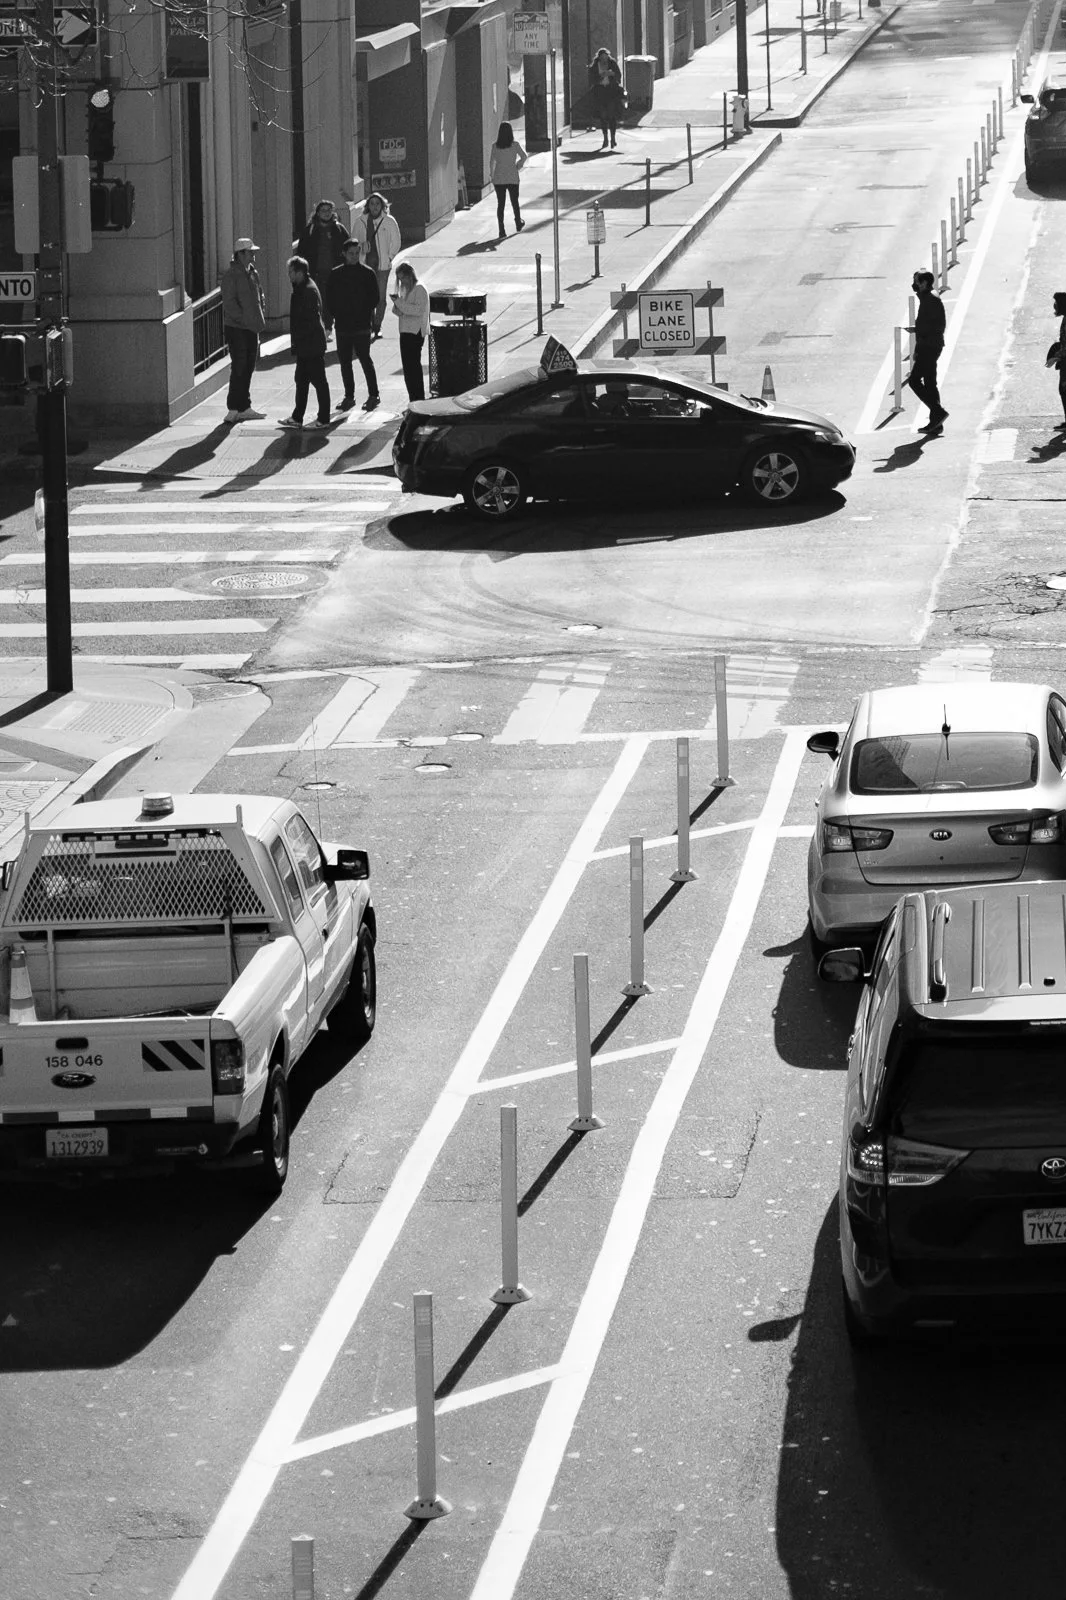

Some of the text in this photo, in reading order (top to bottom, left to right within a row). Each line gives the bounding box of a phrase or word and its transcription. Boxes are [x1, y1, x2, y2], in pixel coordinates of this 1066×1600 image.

[525, 32, 538, 41] ANY
[524, 41, 540, 49] TIME
[383, 140, 403, 149] FDC
[650, 300, 684, 312] BIKE
[648, 315, 686, 327] LANE
[644, 330, 691, 342] CLOSED
[933, 831, 949, 839] KIA
[45, 1055, 103, 1068] 158 046
[51, 1139, 104, 1157] 1312939
